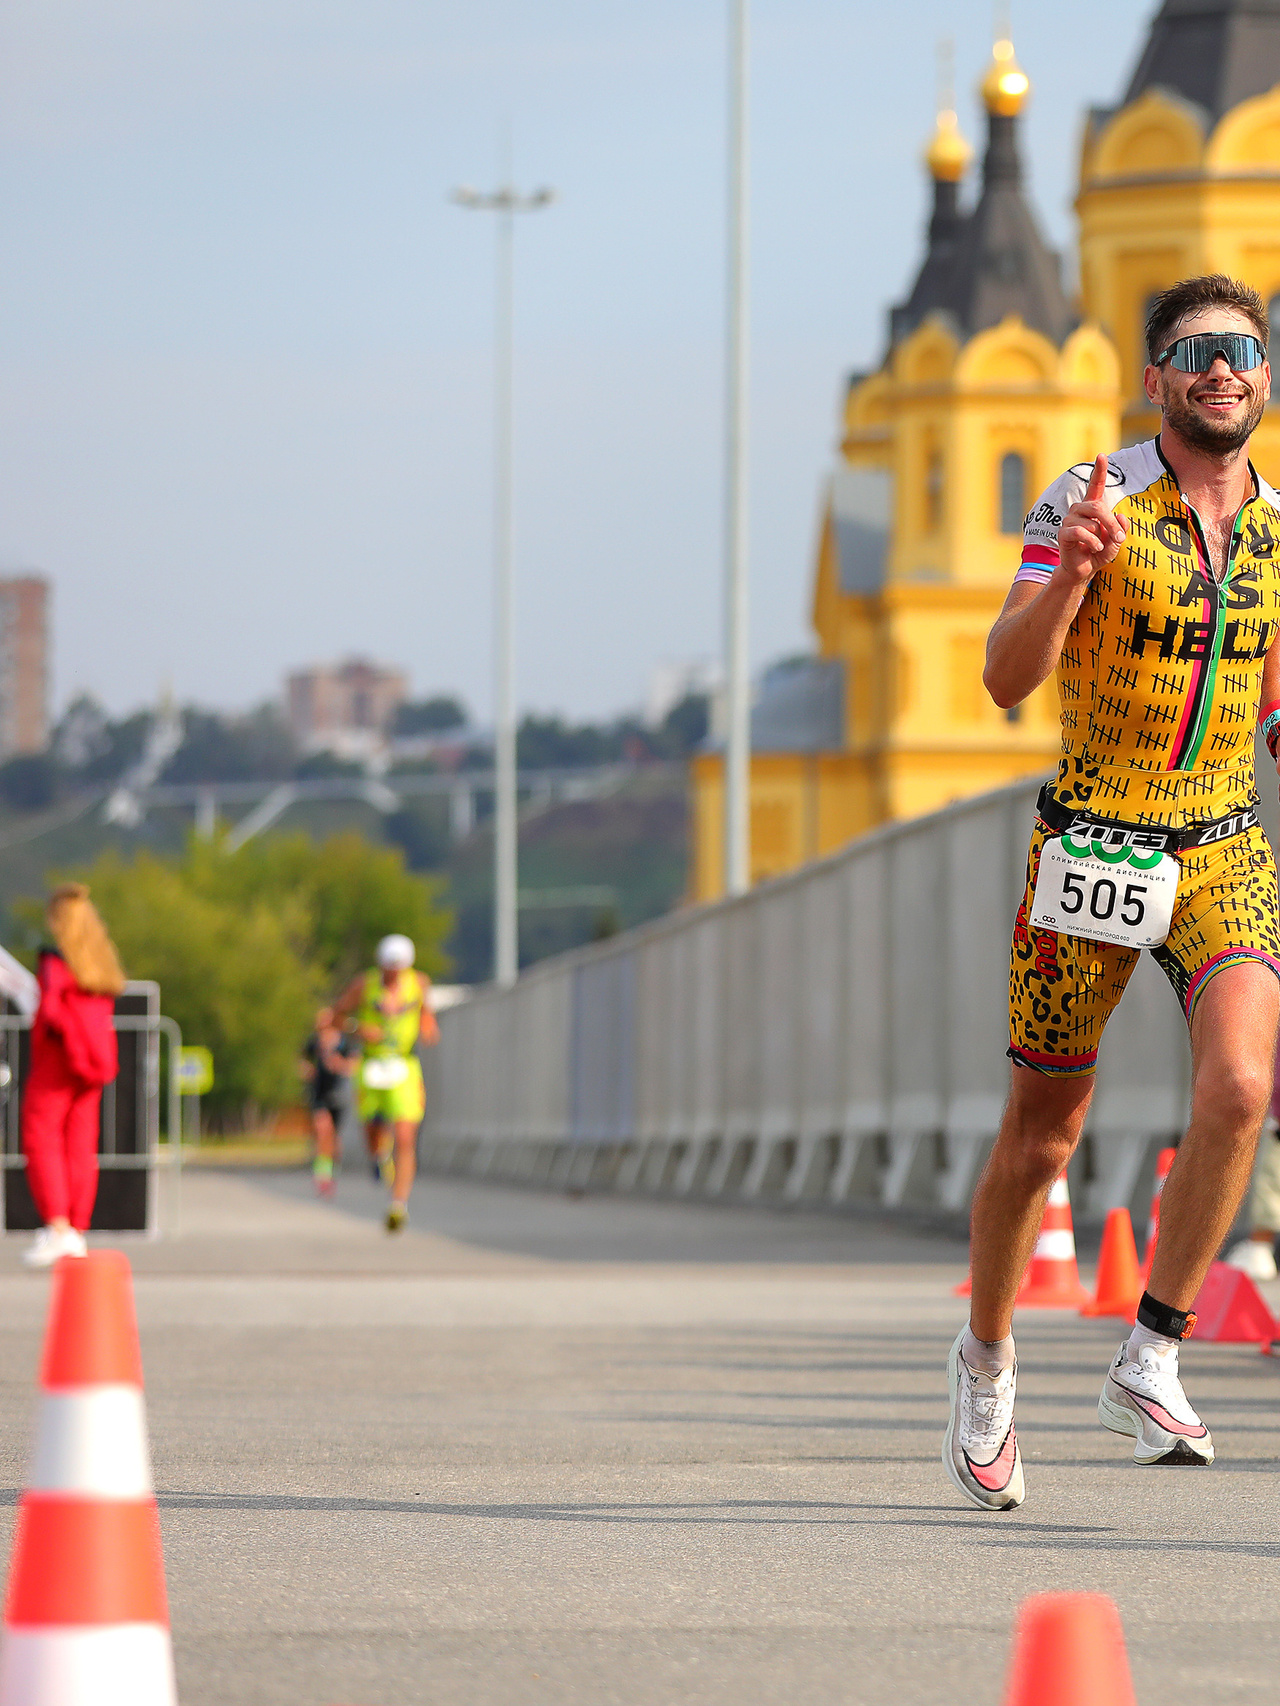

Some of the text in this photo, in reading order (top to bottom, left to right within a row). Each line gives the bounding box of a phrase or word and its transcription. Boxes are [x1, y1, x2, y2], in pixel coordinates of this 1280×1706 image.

[1177, 570, 1259, 610] AS
[1065, 820, 1168, 850] ZONE3
[1051, 855, 1112, 872] ОЛИМПИЙСКАЯ
[1116, 868, 1166, 882] ДИСТАНЦИЯ
[1060, 871, 1149, 927] 505
